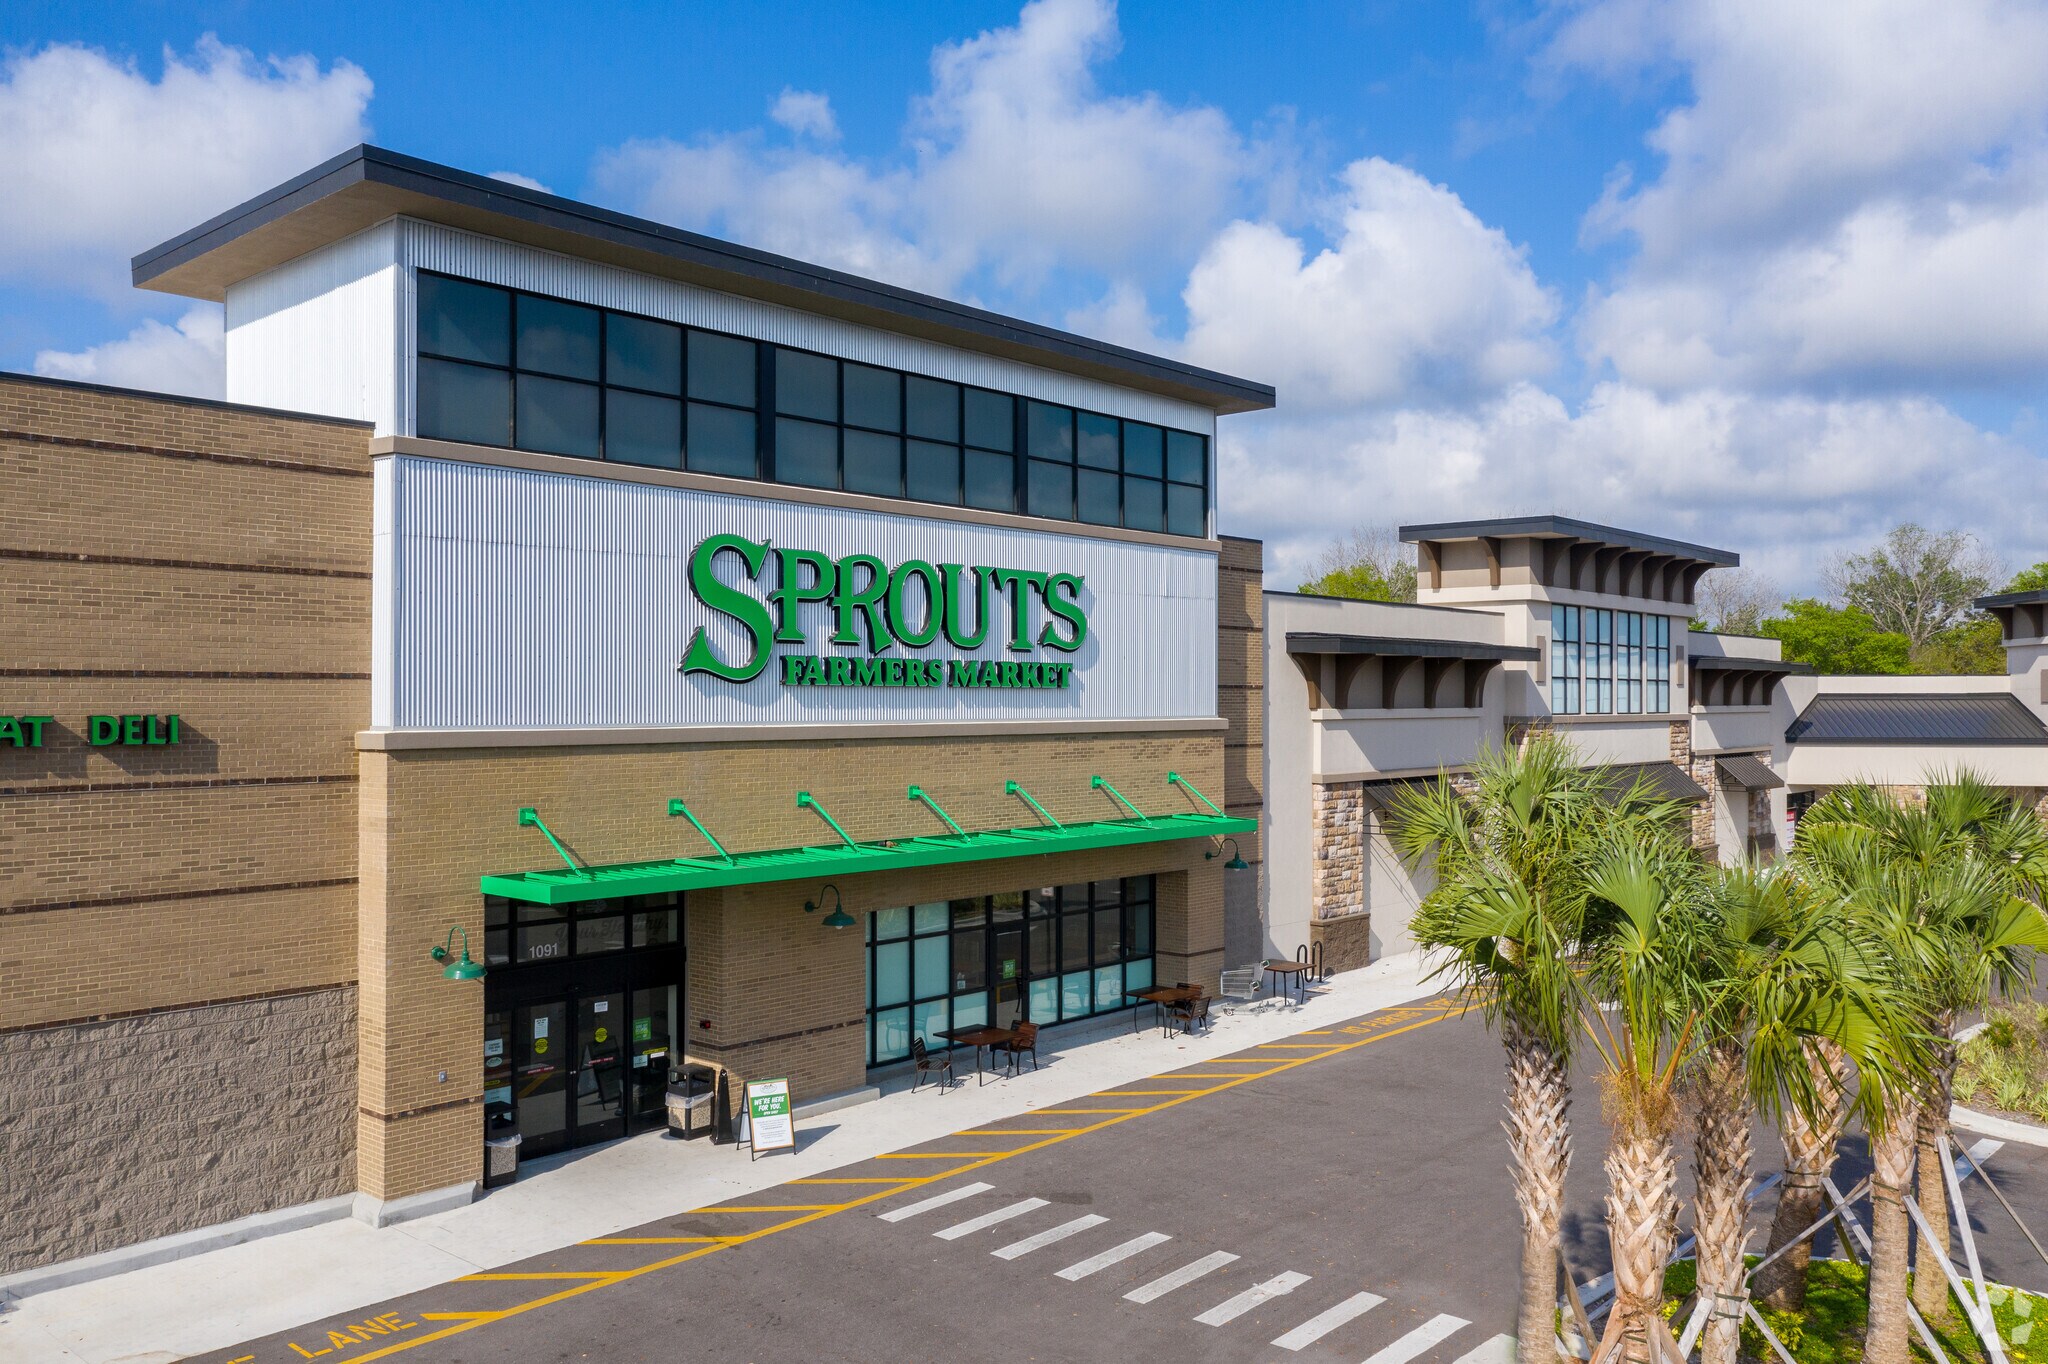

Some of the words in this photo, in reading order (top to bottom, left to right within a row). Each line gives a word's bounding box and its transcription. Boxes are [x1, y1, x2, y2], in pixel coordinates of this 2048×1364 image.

[680, 532, 1087, 684] SPROUTS
[782, 654, 943, 688] FARMERS
[950, 659, 1073, 690] MARKET
[88, 714, 180, 746] DELI
[528, 943, 559, 959] 1091
[754, 1097, 771, 1105] WE'RE
[771, 1095, 784, 1103] HERE
[288, 1311, 418, 1360] LANE
